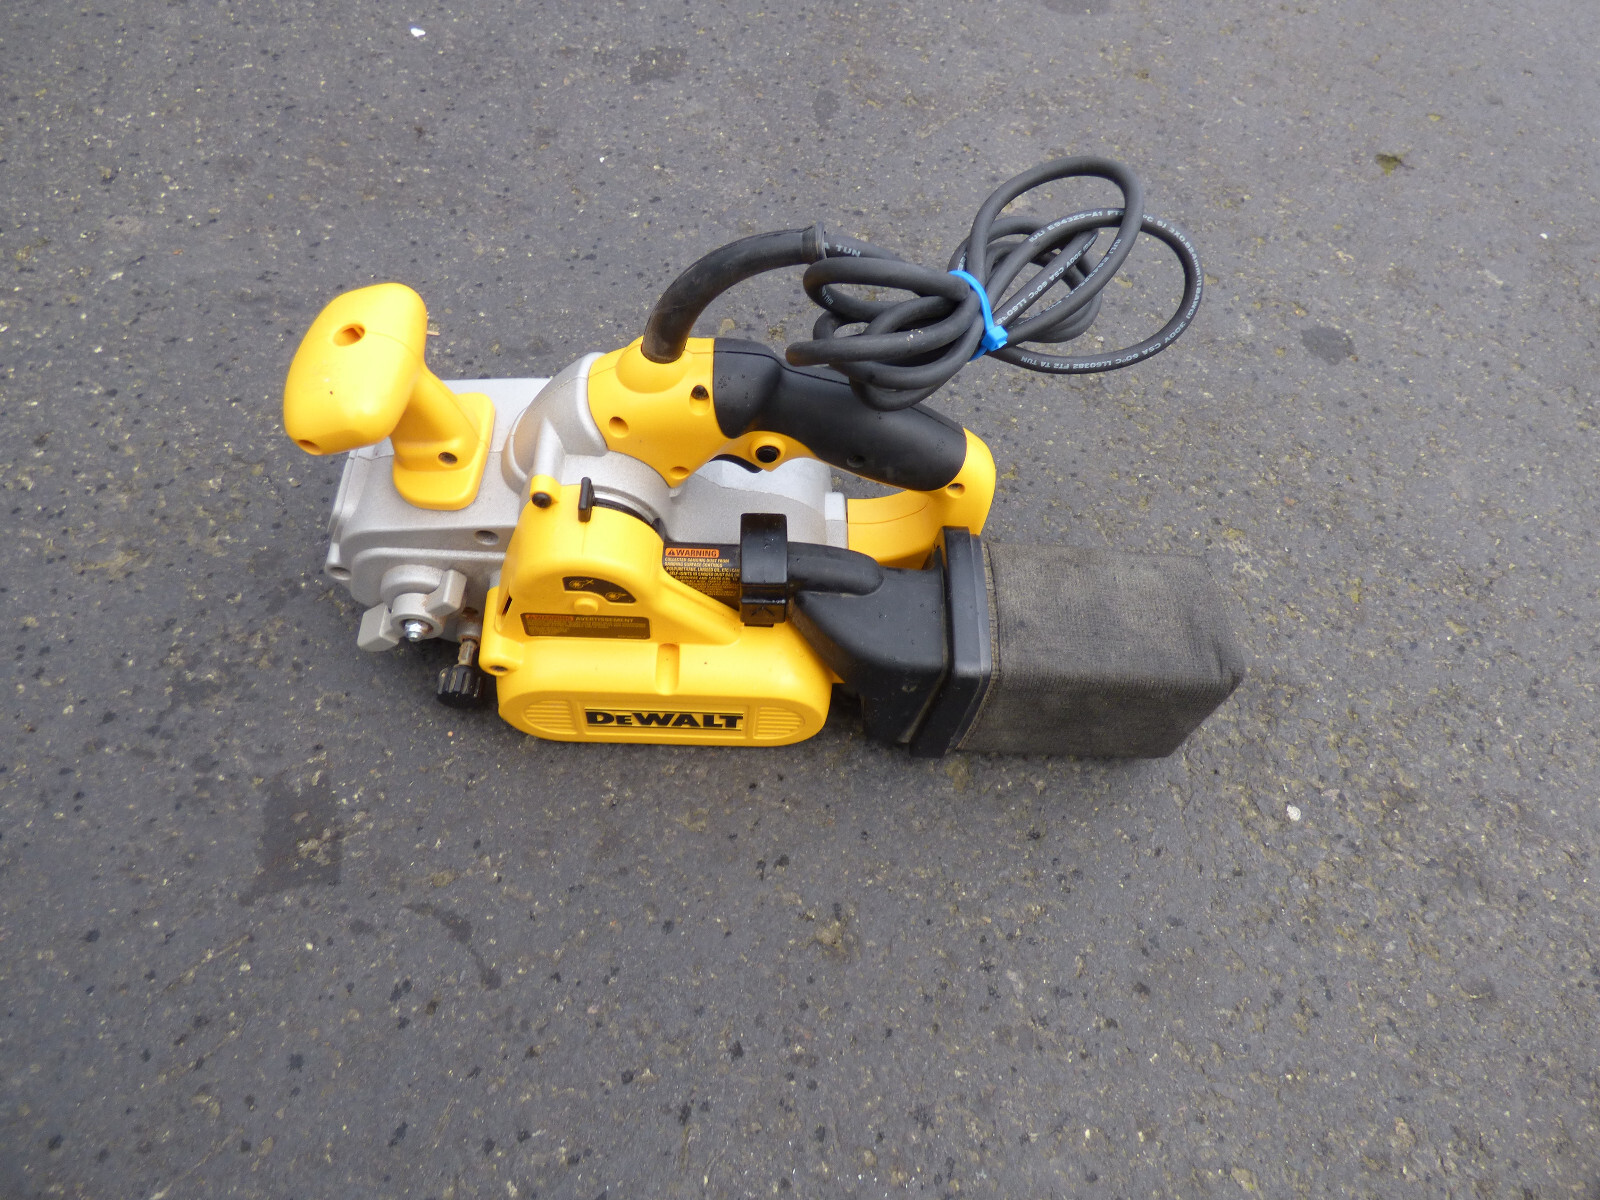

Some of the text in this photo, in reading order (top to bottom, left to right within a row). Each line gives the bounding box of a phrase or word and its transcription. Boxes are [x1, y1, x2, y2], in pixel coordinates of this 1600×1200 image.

[835, 244, 861, 258] TUN
[1164, 321, 1187, 343] 300V
[1141, 342, 1162, 355] CSA
[676, 549, 717, 557] WARNING
